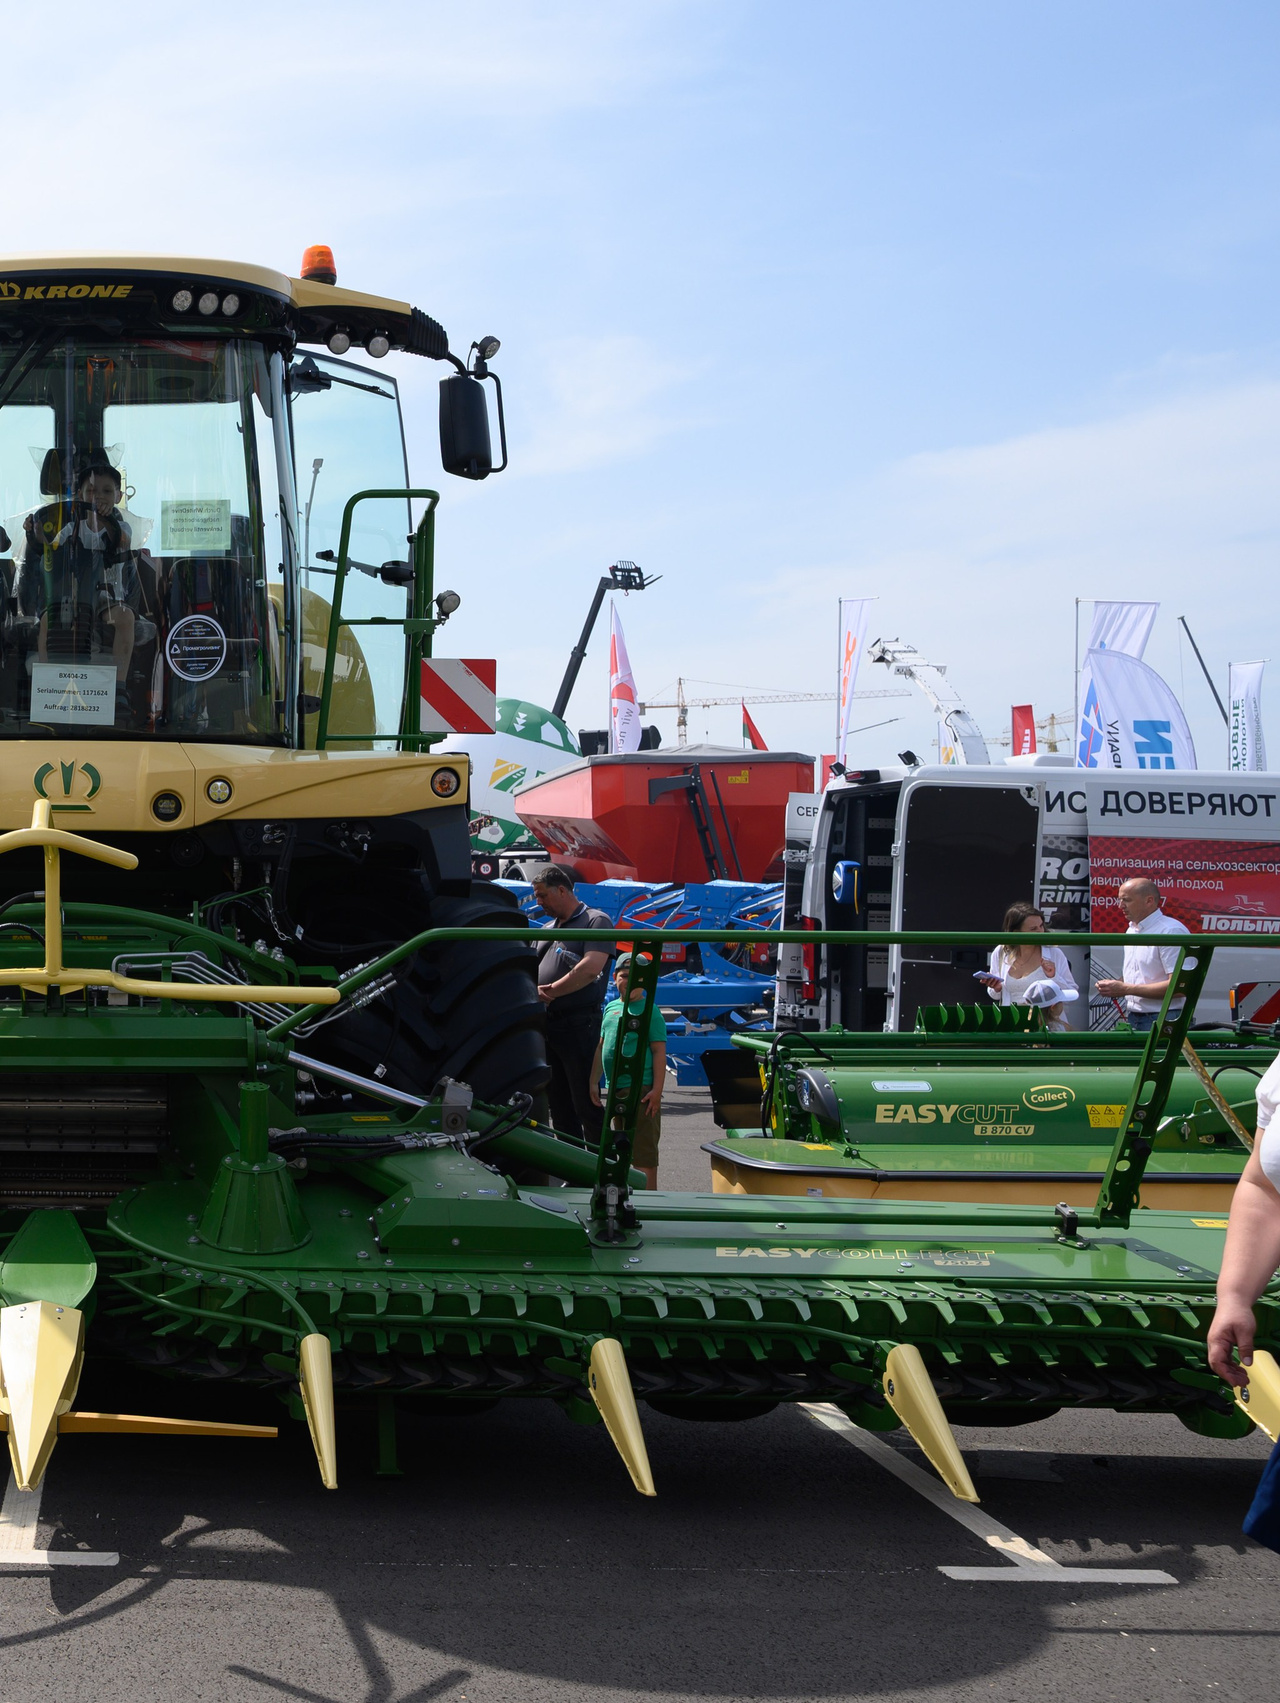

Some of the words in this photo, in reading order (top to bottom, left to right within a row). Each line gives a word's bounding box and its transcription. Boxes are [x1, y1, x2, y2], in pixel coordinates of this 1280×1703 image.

[24, 285, 134, 299] KRONE
[36, 687, 81, 696] Serialnummer:
[43, 703, 69, 712] Auftrag:
[1232, 699, 1241, 771] ДОВЫЕ
[1100, 790, 1277, 817] ДОВЕРЯЮТ
[796, 806, 819, 817] СЕР
[1089, 857, 1165, 869] циализация
[1167, 860, 1184, 869] на
[1177, 879, 1224, 891] подход
[1030, 1091, 1067, 1103] Collect
[980, 1126, 989, 1135] B
[990, 1126, 1012, 1135] 870
[1014, 1126, 1031, 1135] CV
